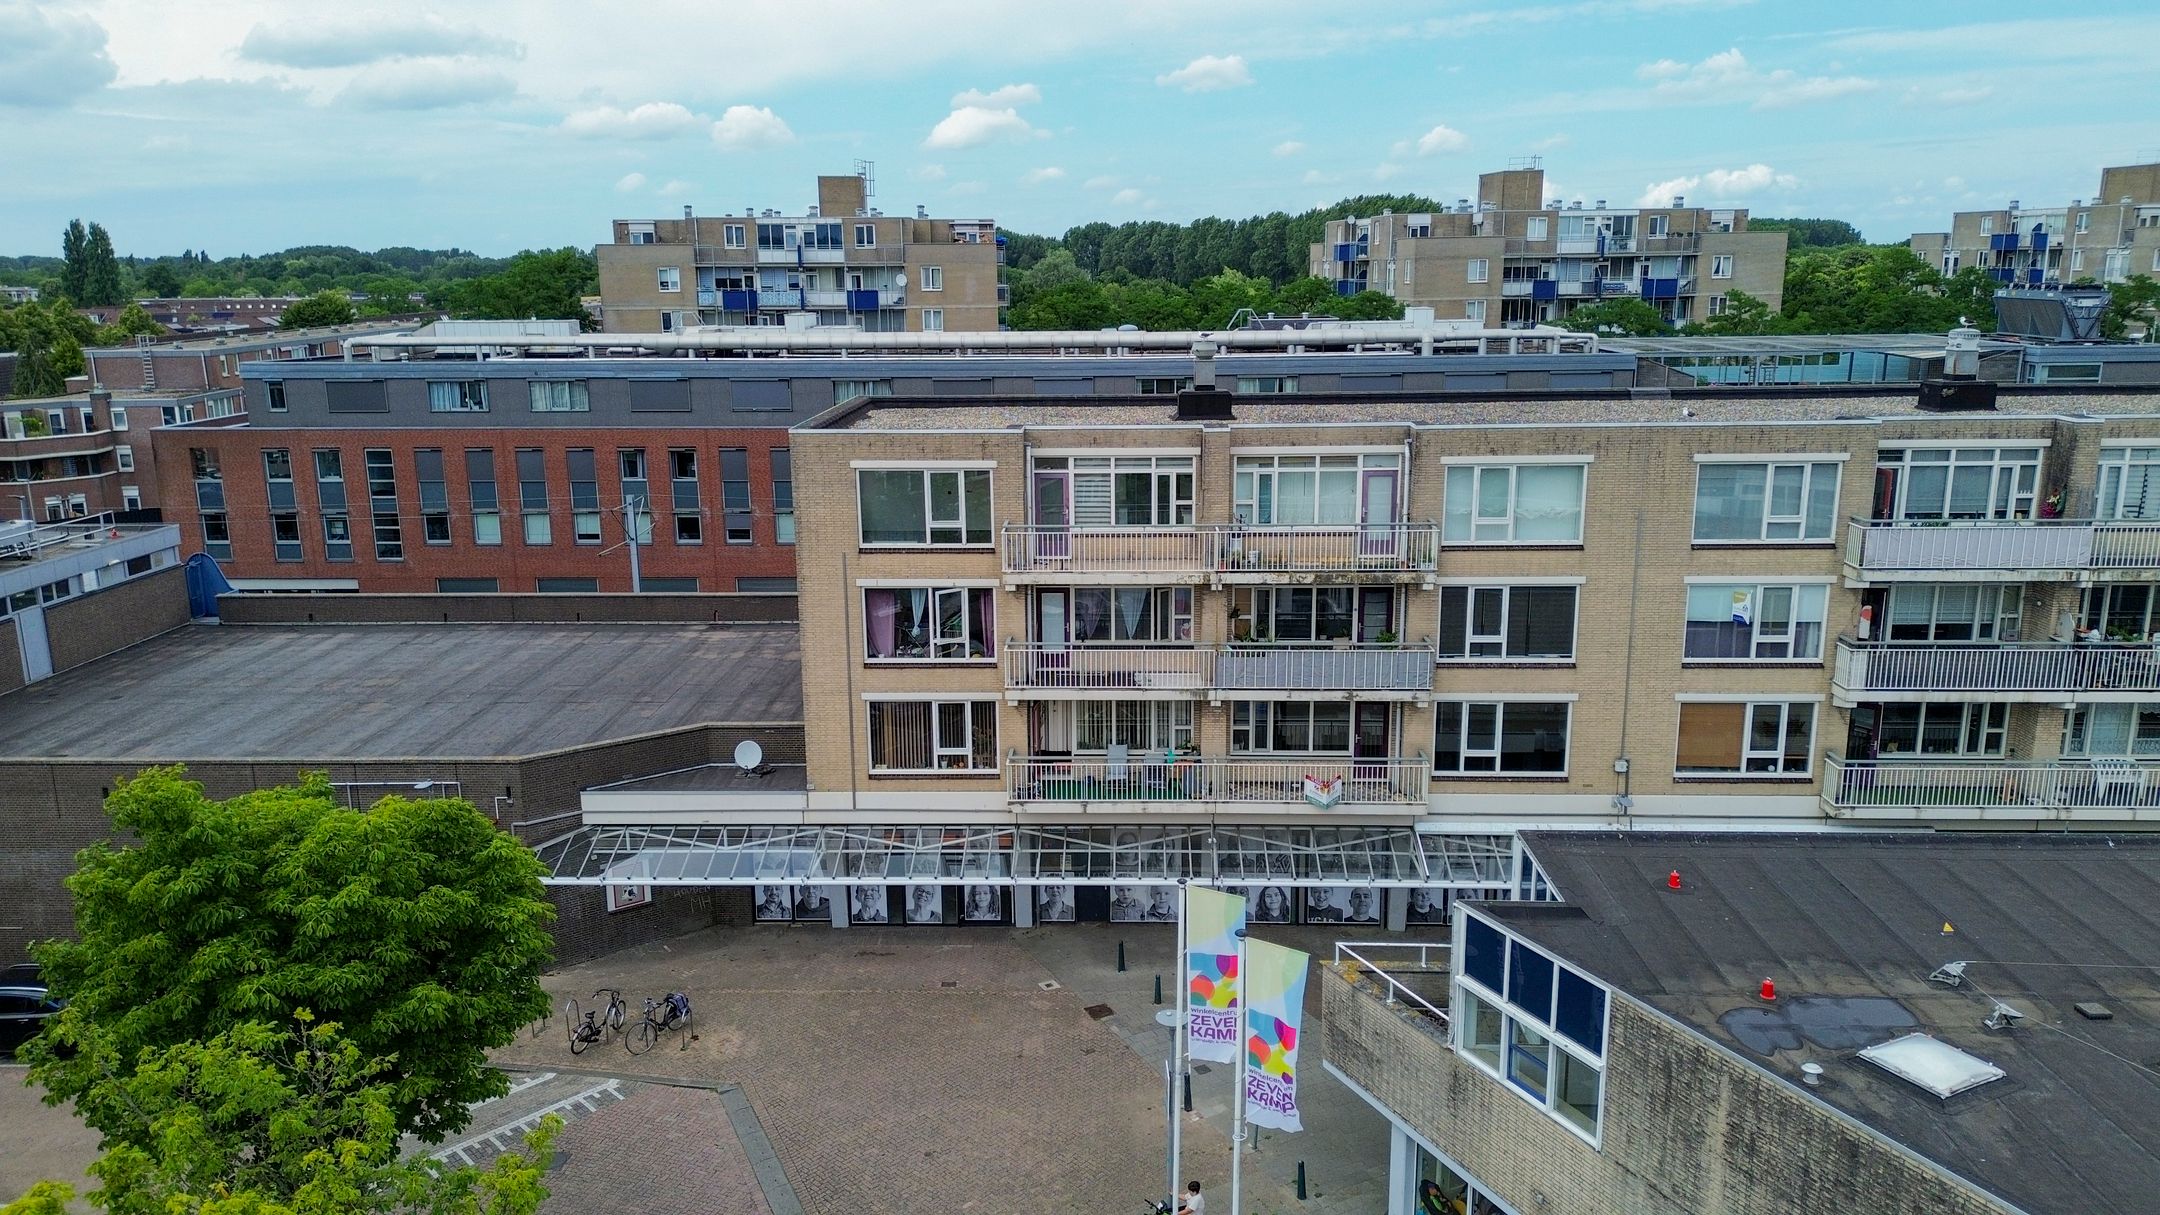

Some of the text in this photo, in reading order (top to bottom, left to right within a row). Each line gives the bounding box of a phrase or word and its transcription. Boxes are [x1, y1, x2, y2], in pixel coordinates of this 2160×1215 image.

[1190, 1007, 1237, 1016] winkelcentru
[1247, 1086, 1295, 1114] KAMP
[1248, 1074, 1293, 1102] ZEVEN
